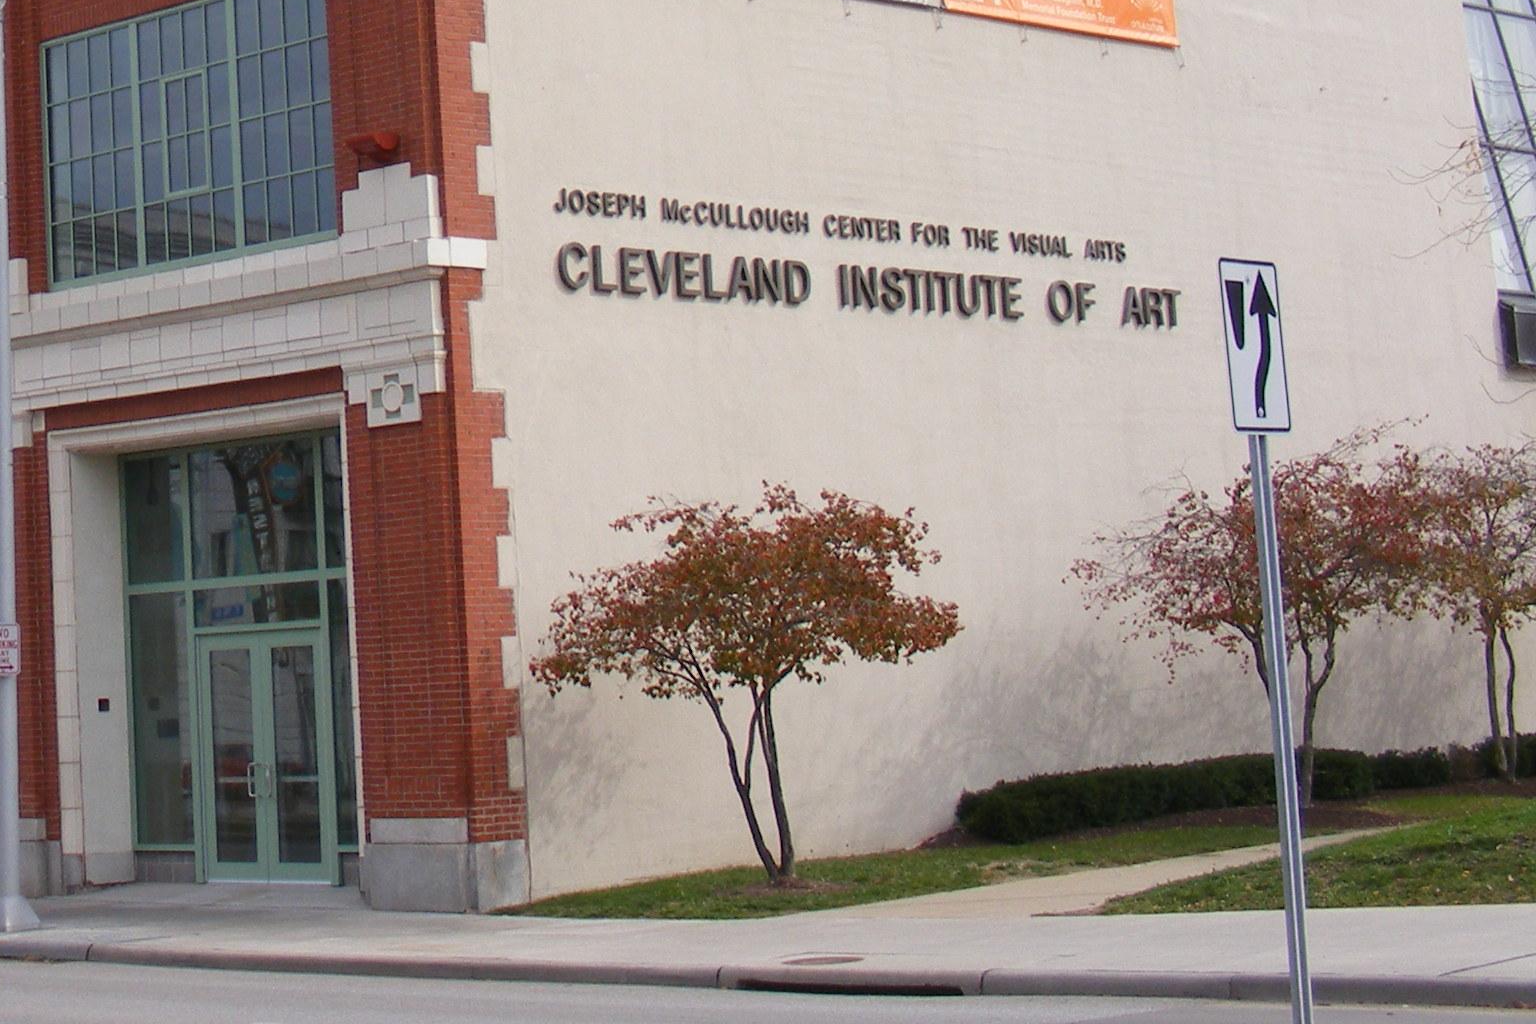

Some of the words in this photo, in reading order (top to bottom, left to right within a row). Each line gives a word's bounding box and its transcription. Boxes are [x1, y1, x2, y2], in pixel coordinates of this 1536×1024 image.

[553, 187, 647, 219] JOSEPH
[661, 197, 810, 235] McCULLOUGH
[823, 214, 901, 242] CENTER
[910, 222, 950, 248] FOR
[962, 226, 999, 252] THE
[1009, 231, 1073, 259] VISUAL
[1084, 238, 1127, 263] ARTS
[557, 241, 812, 306] CLEVELAND
[836, 264, 1024, 323] INSTITUTE
[1047, 279, 1096, 325] OF
[1122, 285, 1181, 330] ART
